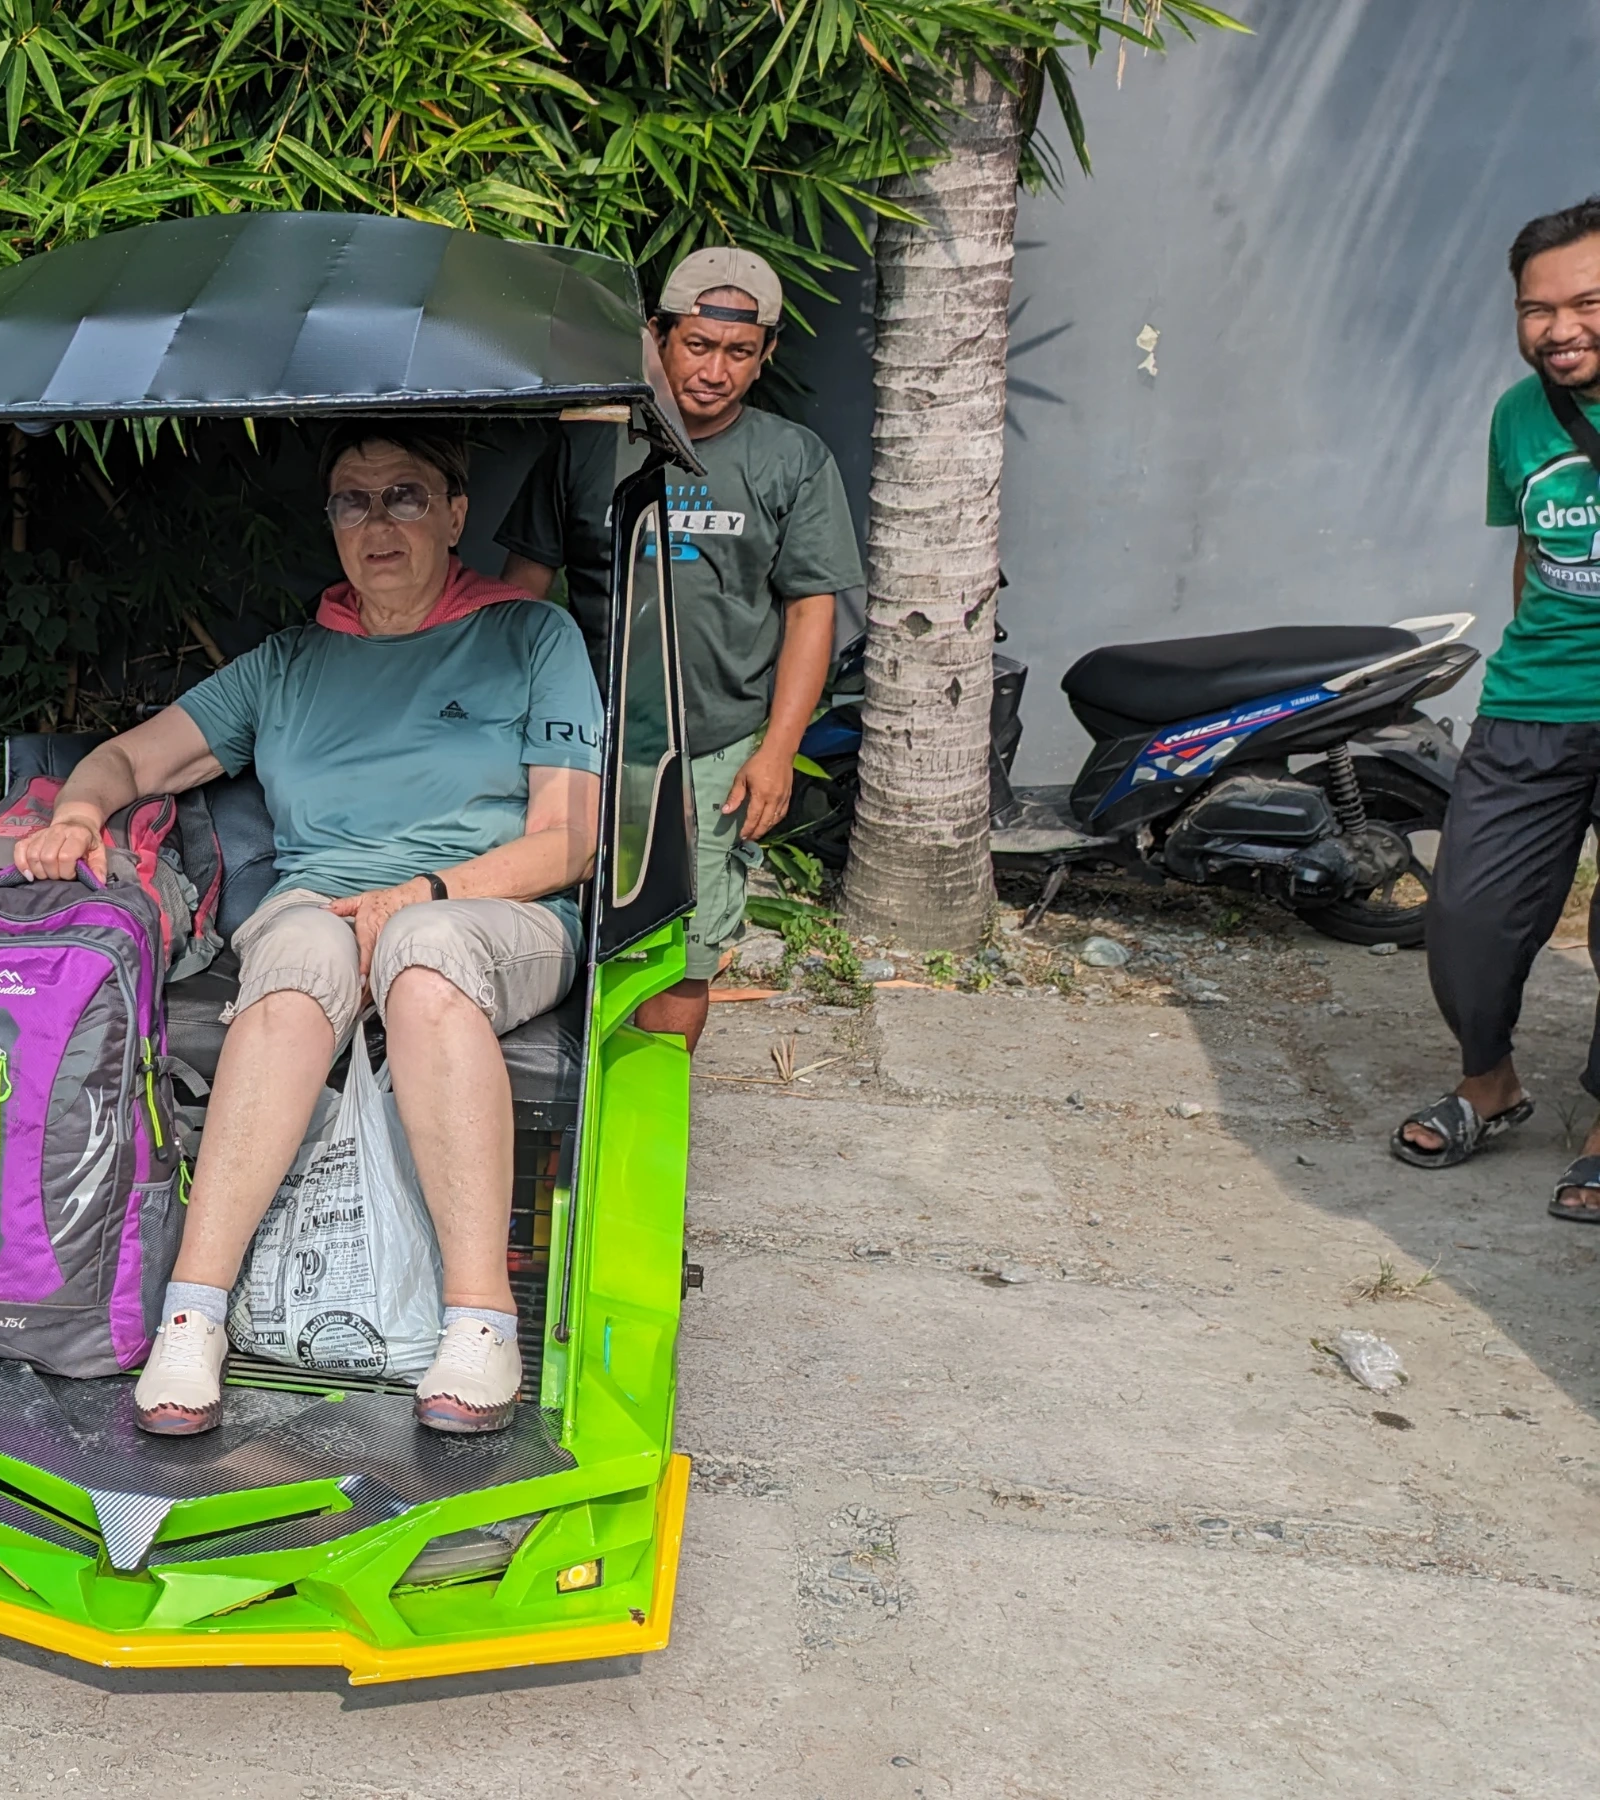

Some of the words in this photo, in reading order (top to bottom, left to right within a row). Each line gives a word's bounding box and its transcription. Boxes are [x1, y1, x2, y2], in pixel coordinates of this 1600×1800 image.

[1290, 693, 1320, 707] YAMAHA
[439, 709, 470, 720] PEAK
[1163, 718, 1232, 745] MIO
[1234, 703, 1283, 725] 125
[545, 721, 604, 754] RU
[325, 1238, 365, 1250] LEGRAIN
[301, 1314, 348, 1345] Meilleur
[310, 1359, 352, 1369] POUDRE
